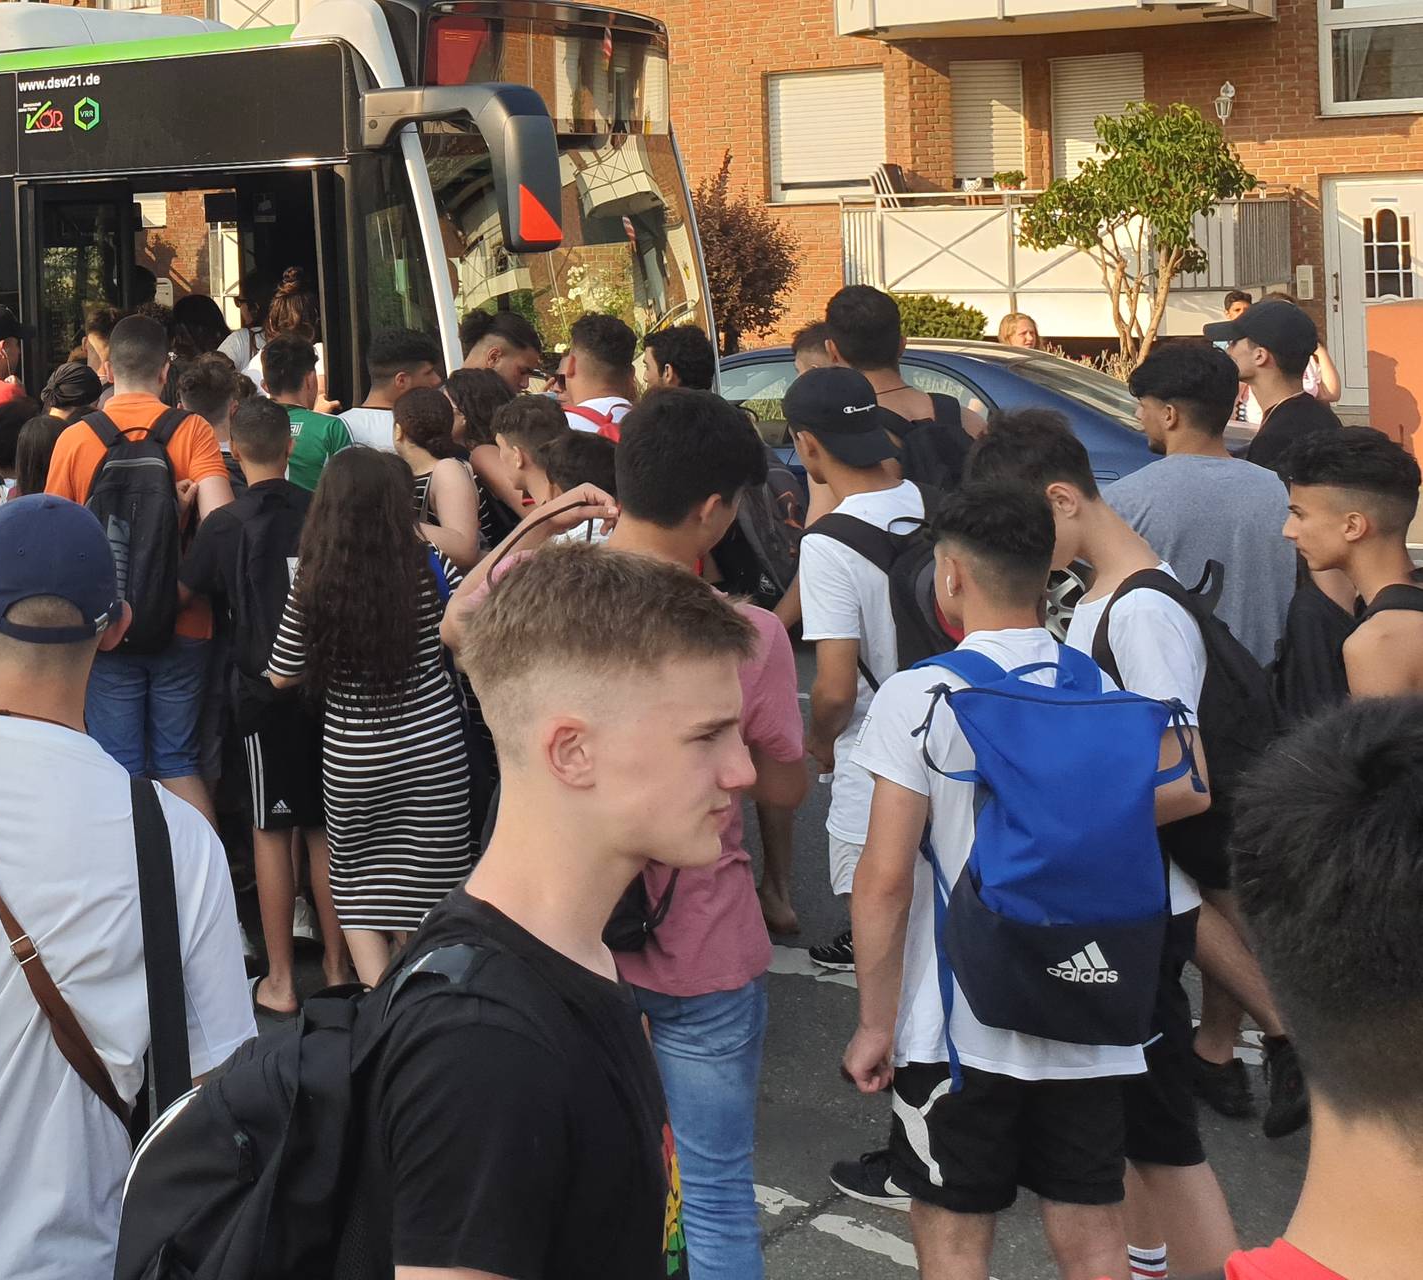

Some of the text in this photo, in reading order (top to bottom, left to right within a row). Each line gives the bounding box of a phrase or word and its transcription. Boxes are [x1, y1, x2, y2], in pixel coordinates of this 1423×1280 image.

[18, 73, 101, 92] www.dsw21.de
[79, 109, 94, 118] VRR
[1046, 966, 1119, 983] adidas
